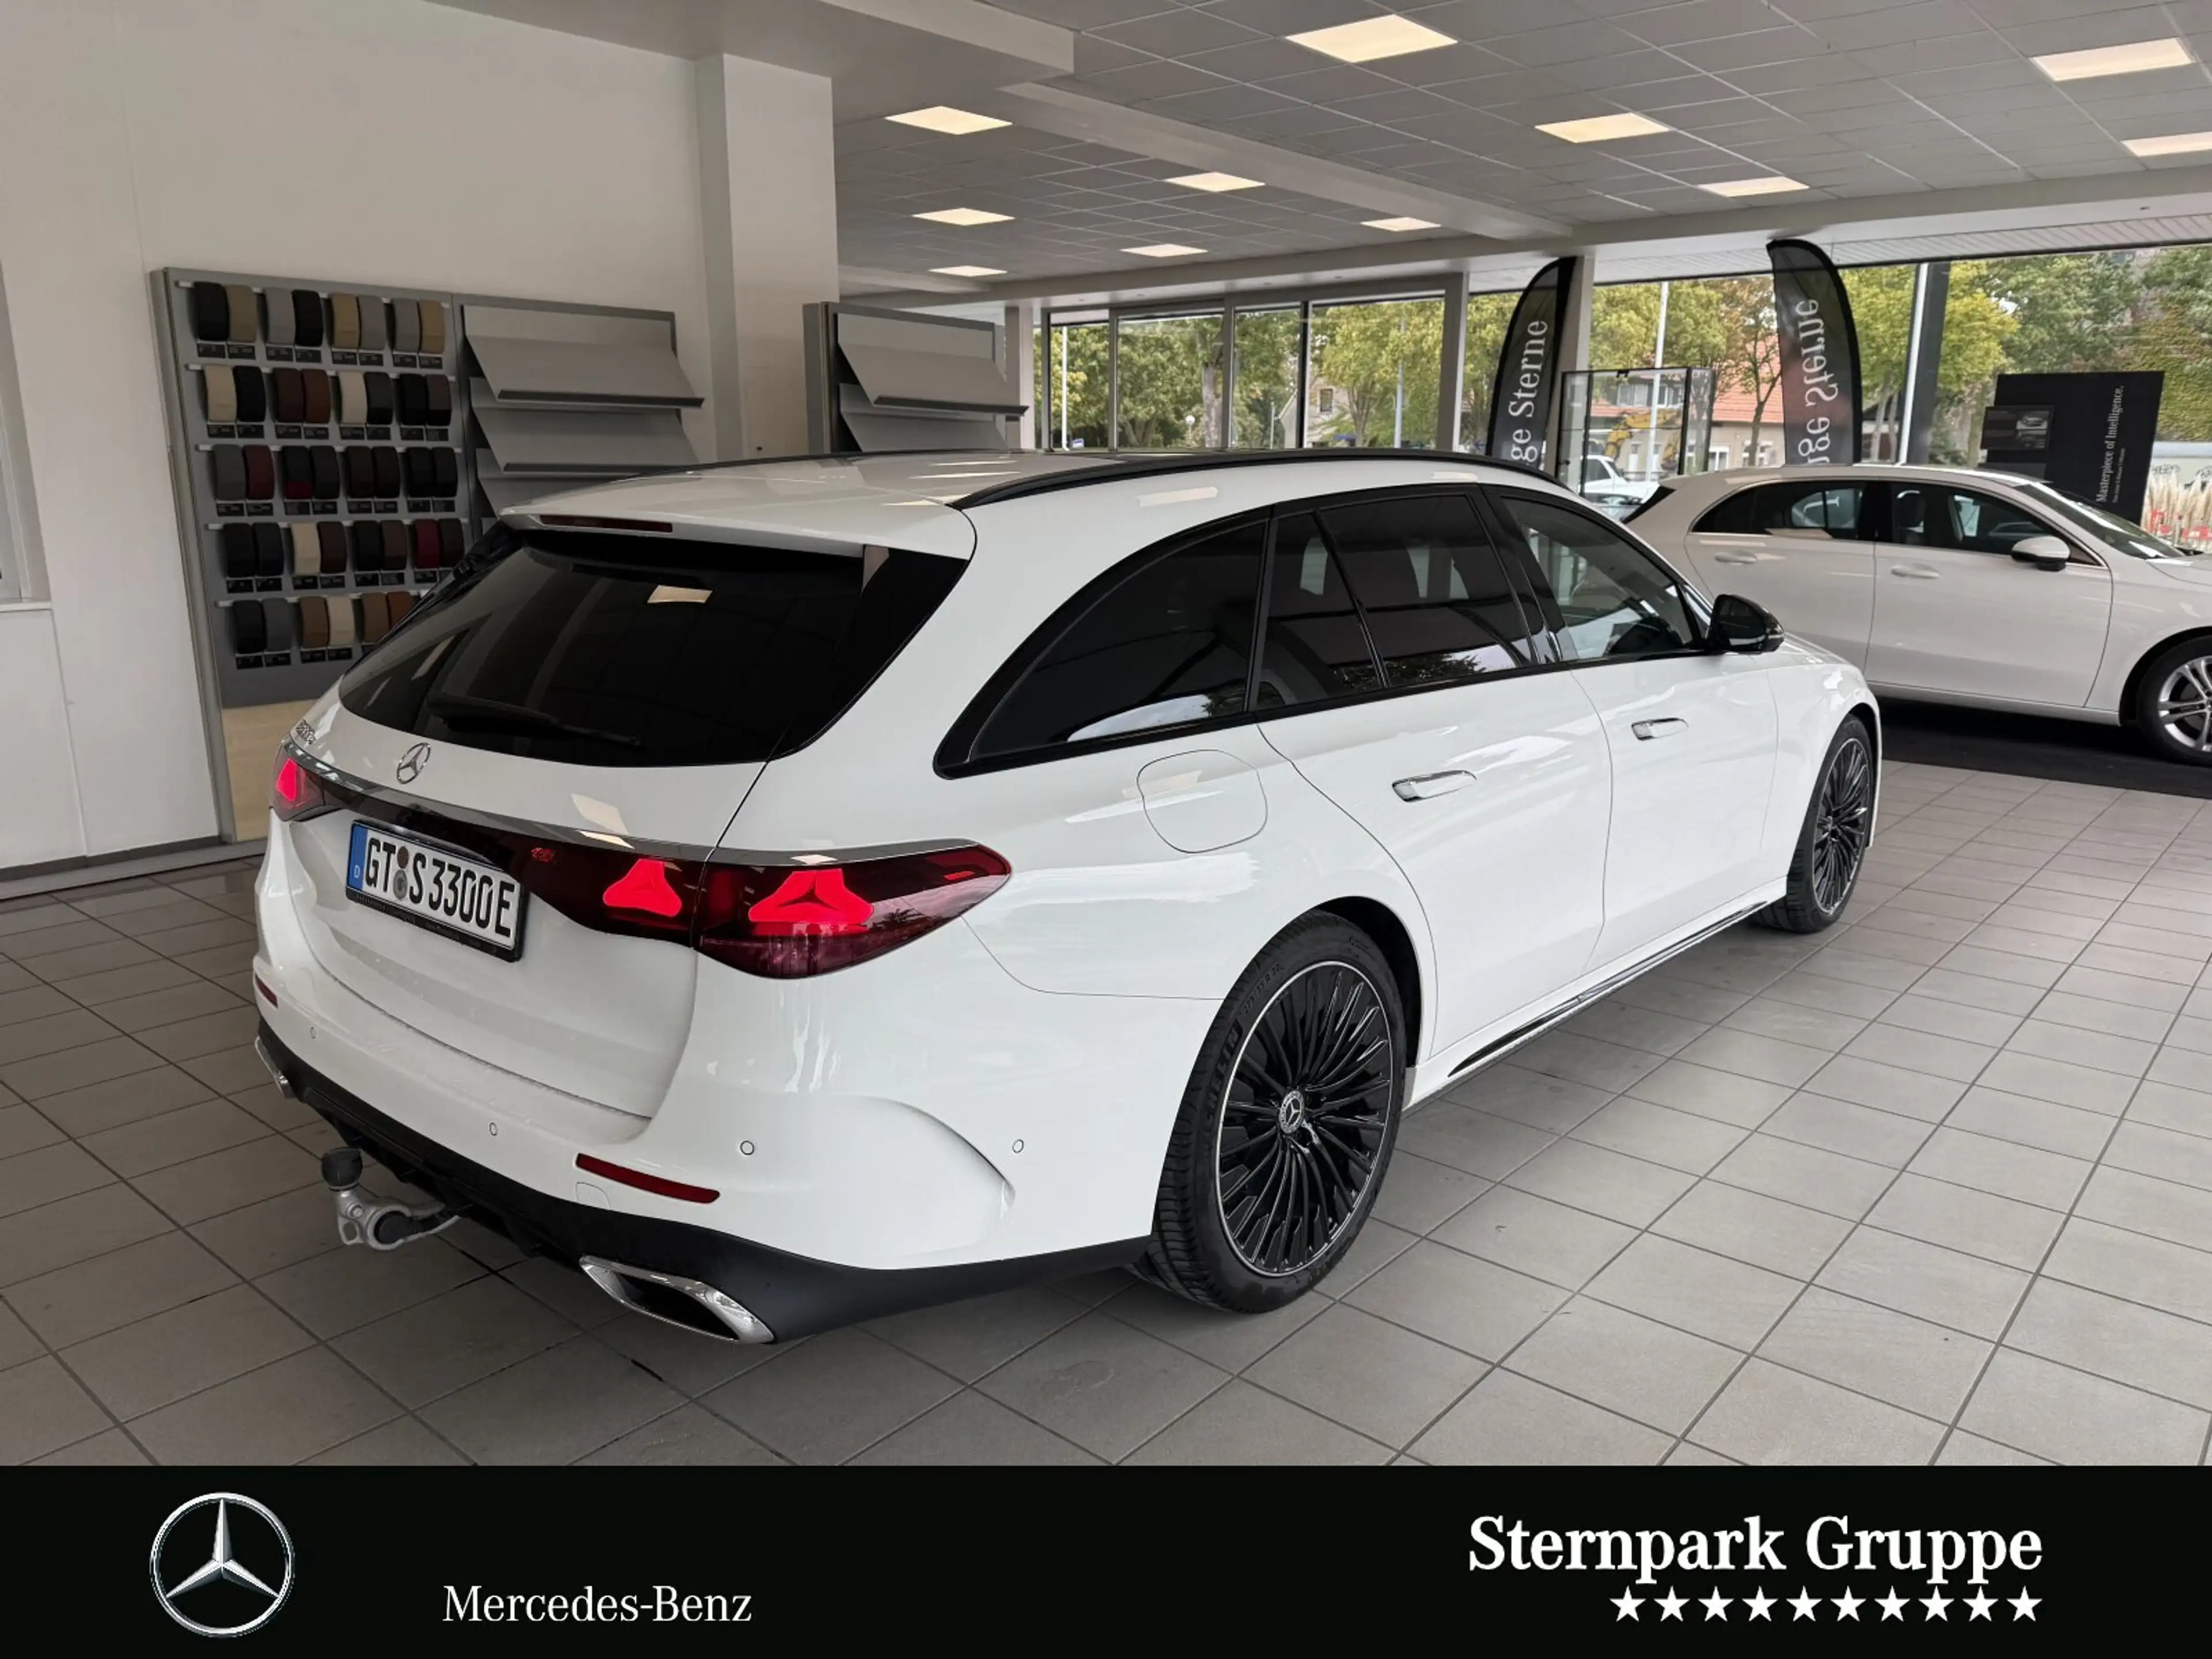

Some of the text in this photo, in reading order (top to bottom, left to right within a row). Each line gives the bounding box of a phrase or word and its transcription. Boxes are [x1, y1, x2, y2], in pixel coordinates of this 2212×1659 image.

[1508, 320, 1548, 418] Sterne
[2104, 440, 2116, 450] of
[2095, 450, 2115, 503] Masterpiece
[365, 838, 396, 892] GT
